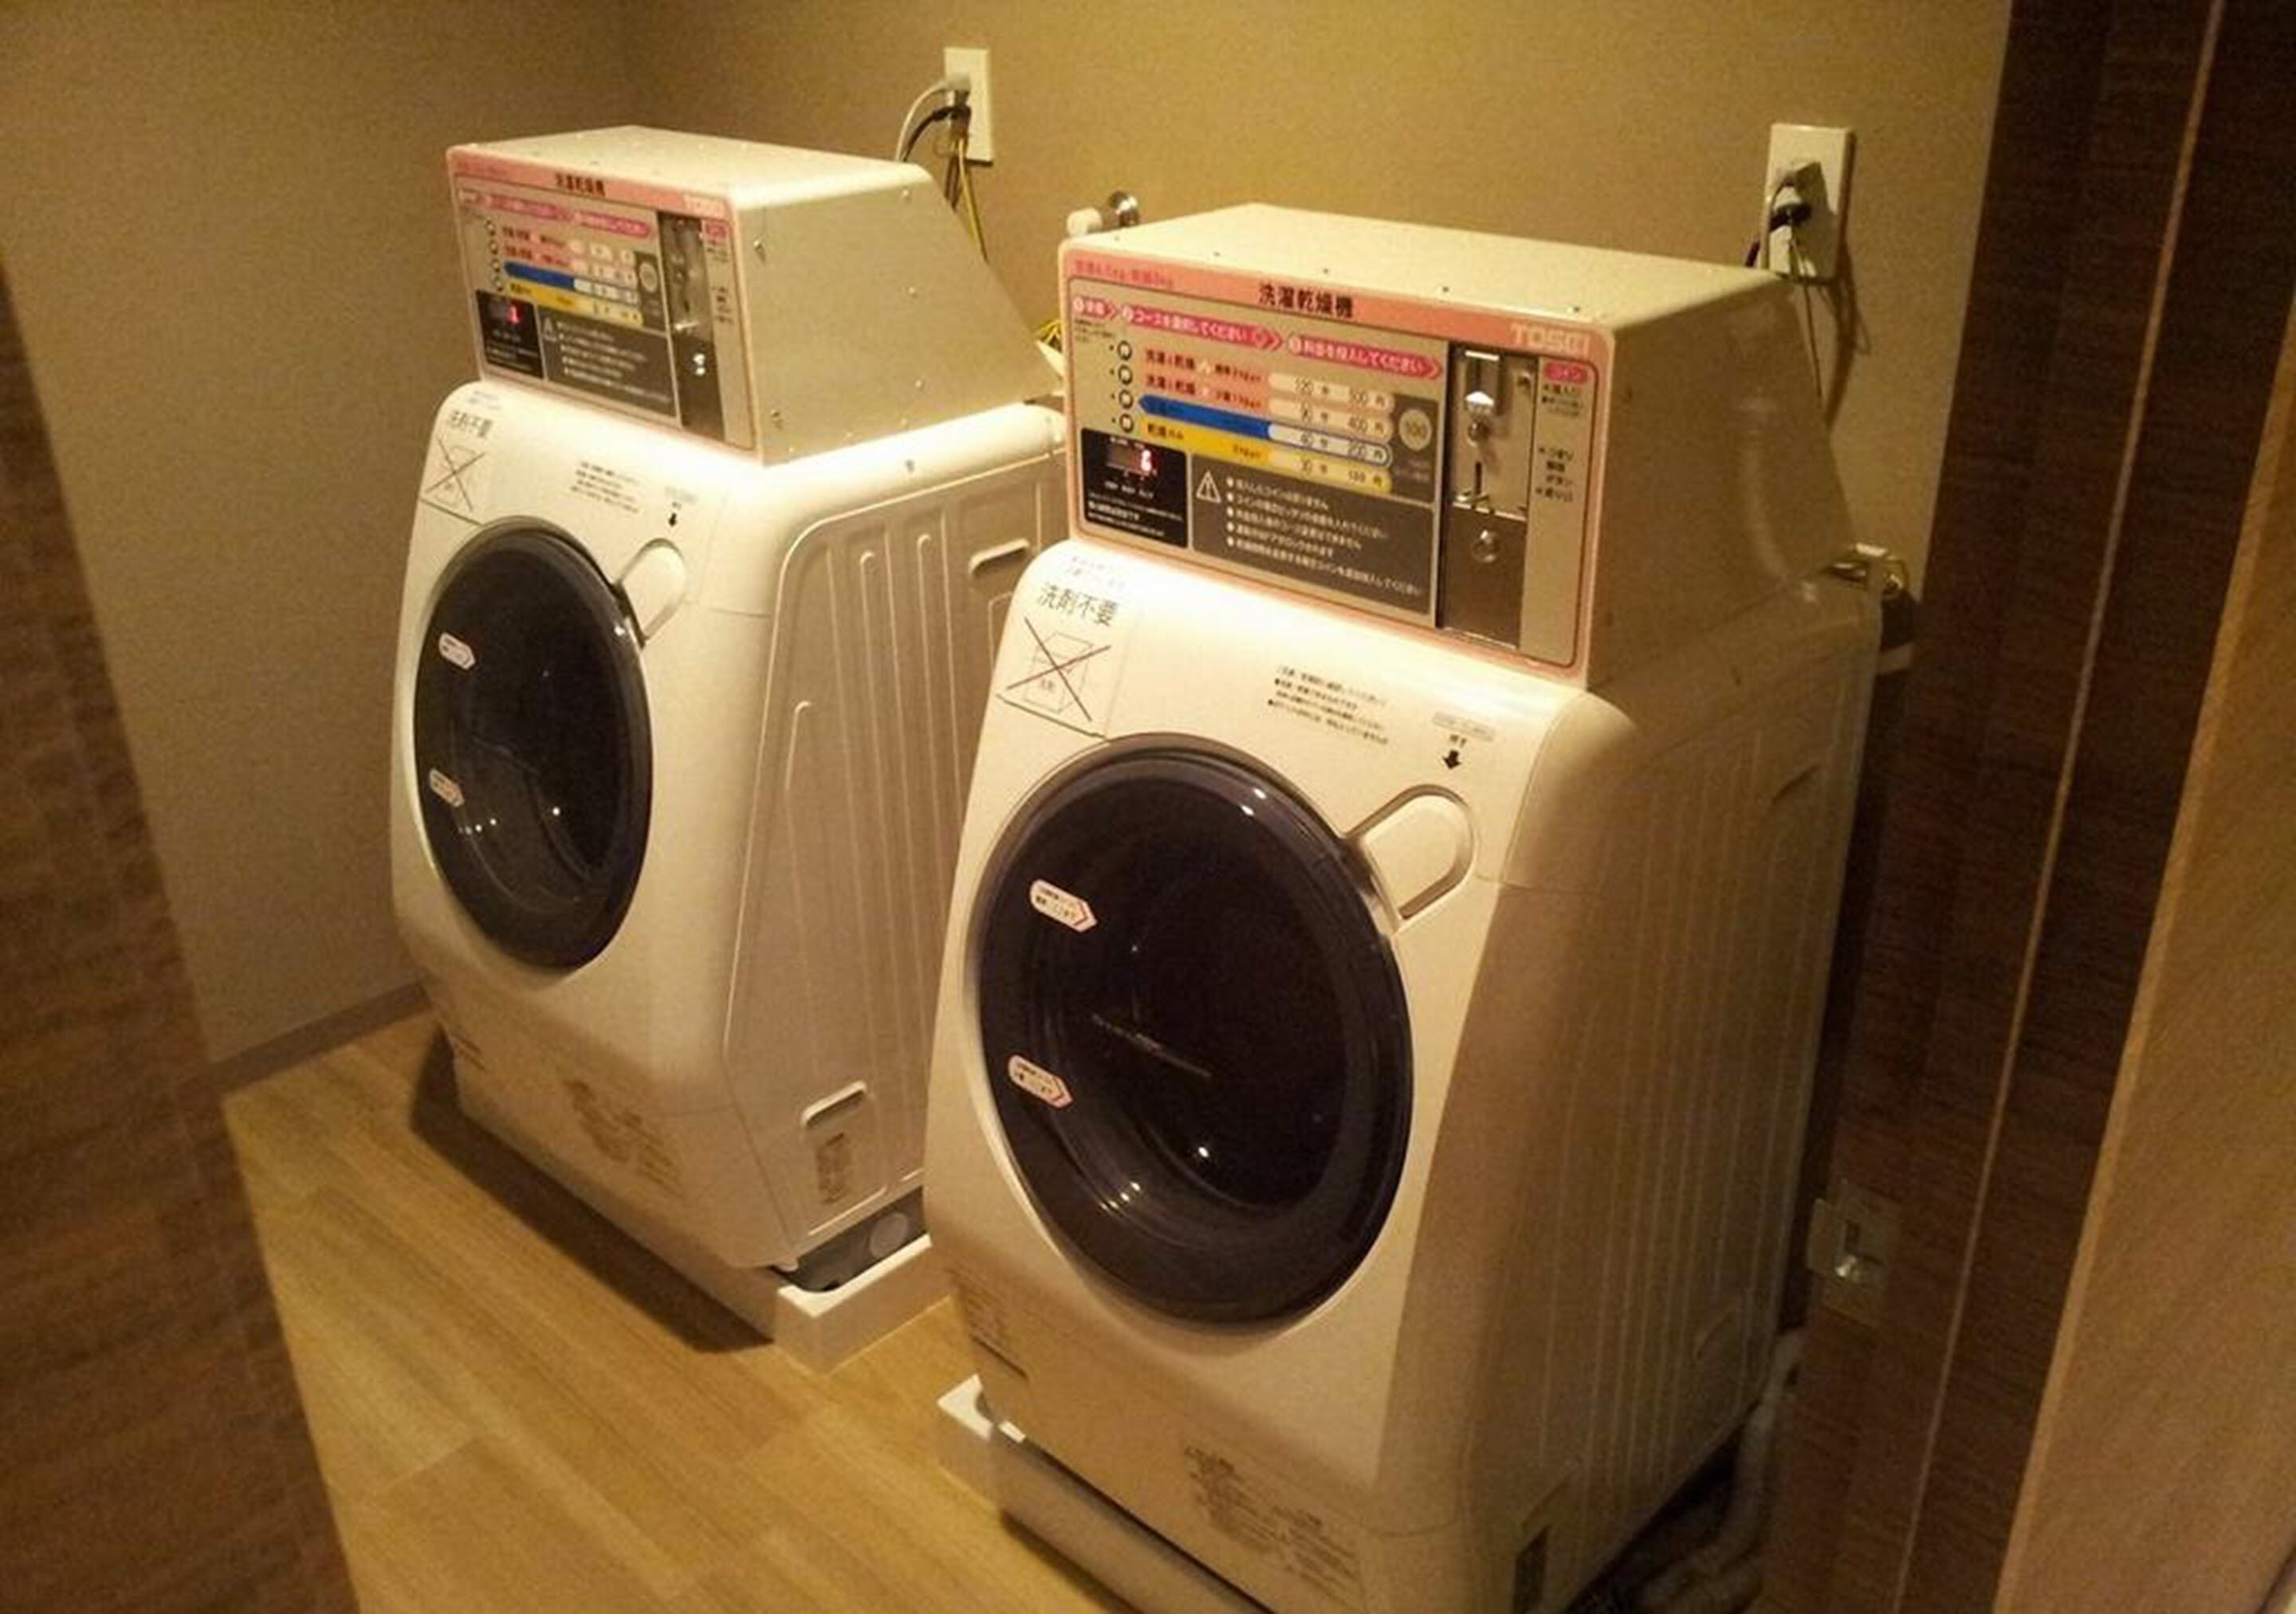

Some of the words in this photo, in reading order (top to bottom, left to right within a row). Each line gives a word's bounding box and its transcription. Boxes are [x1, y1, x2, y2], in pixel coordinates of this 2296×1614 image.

[1259, 282, 1353, 319] 洗濯乾燥機
[1039, 582, 1119, 626] 洗剤不要
